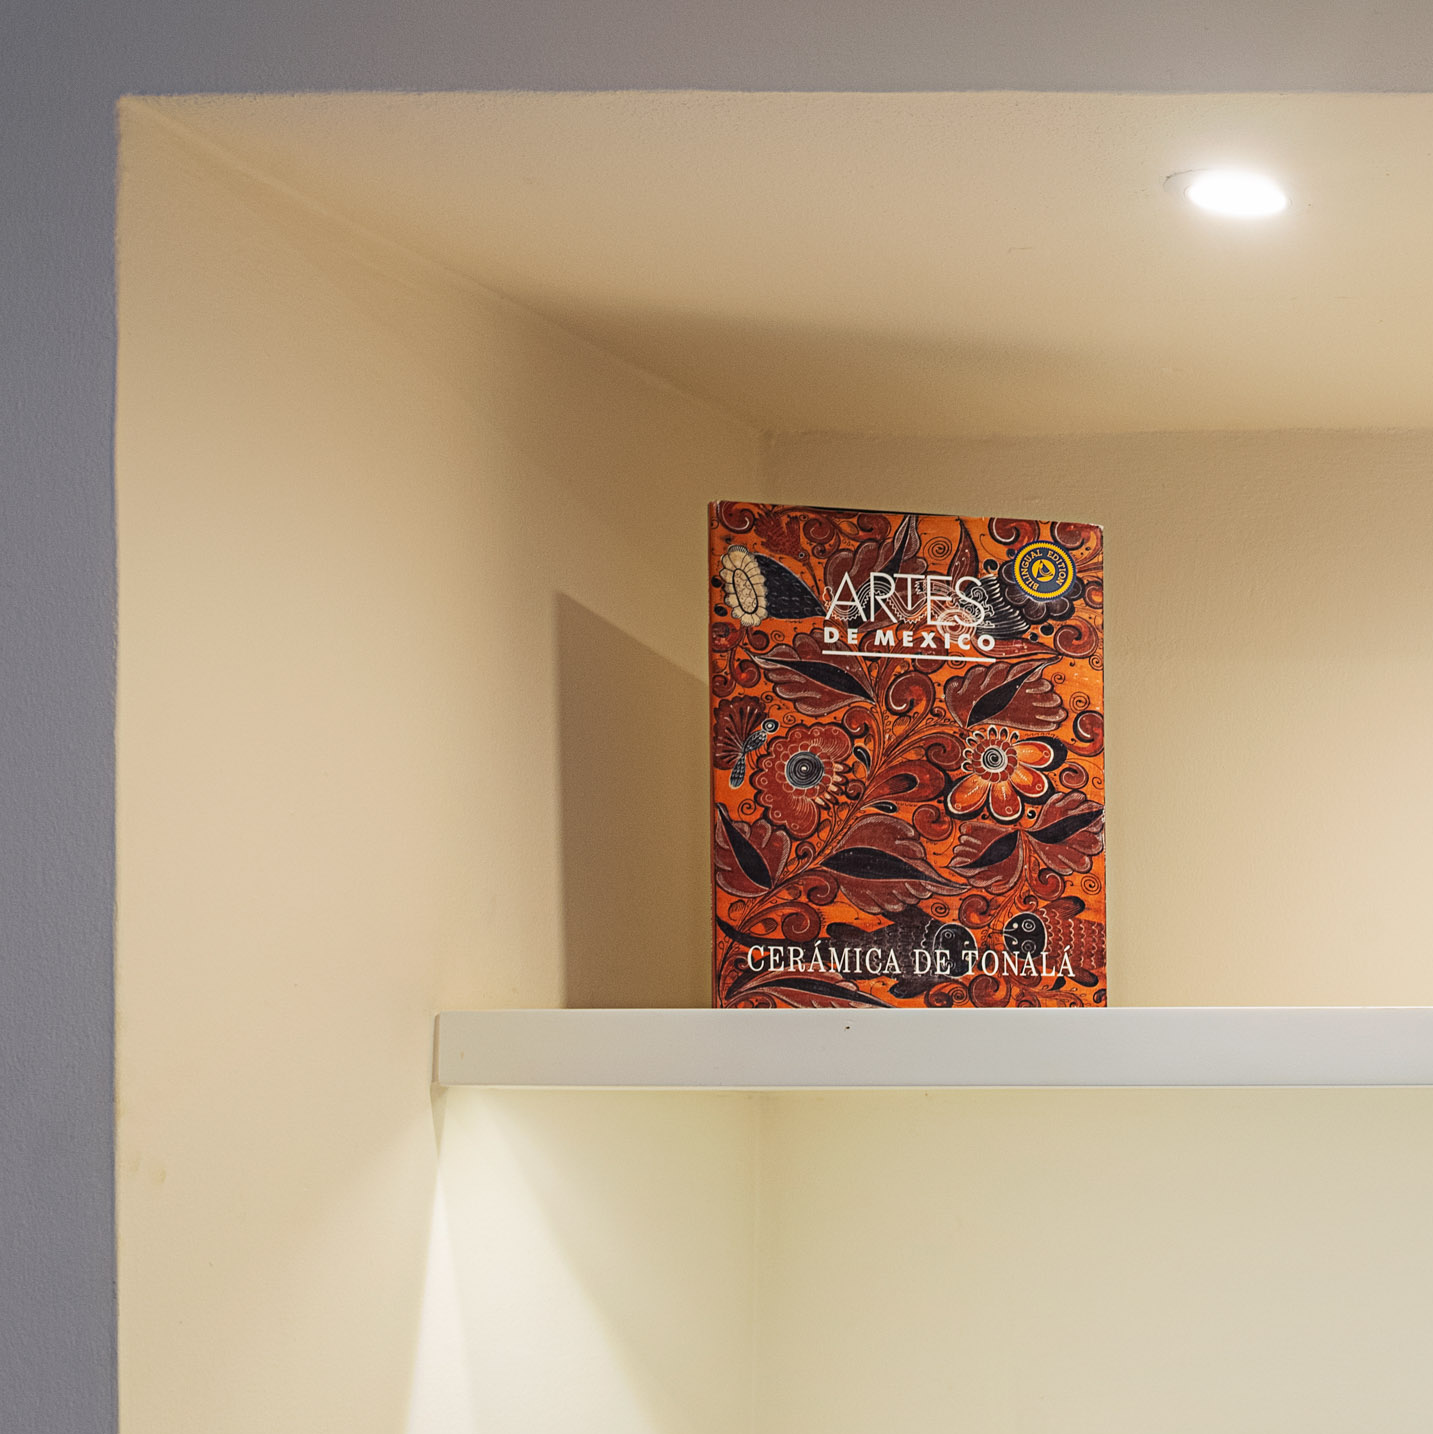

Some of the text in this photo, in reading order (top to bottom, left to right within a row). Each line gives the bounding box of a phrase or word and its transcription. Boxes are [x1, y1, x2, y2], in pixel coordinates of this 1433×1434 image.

[1021, 549, 1067, 590] BILINGUAL EDITION
[825, 571, 985, 627] ARTES
[823, 626, 995, 651] DE MEXICO
[747, 940, 1076, 977] CERÁMICA DE TONALÁ
